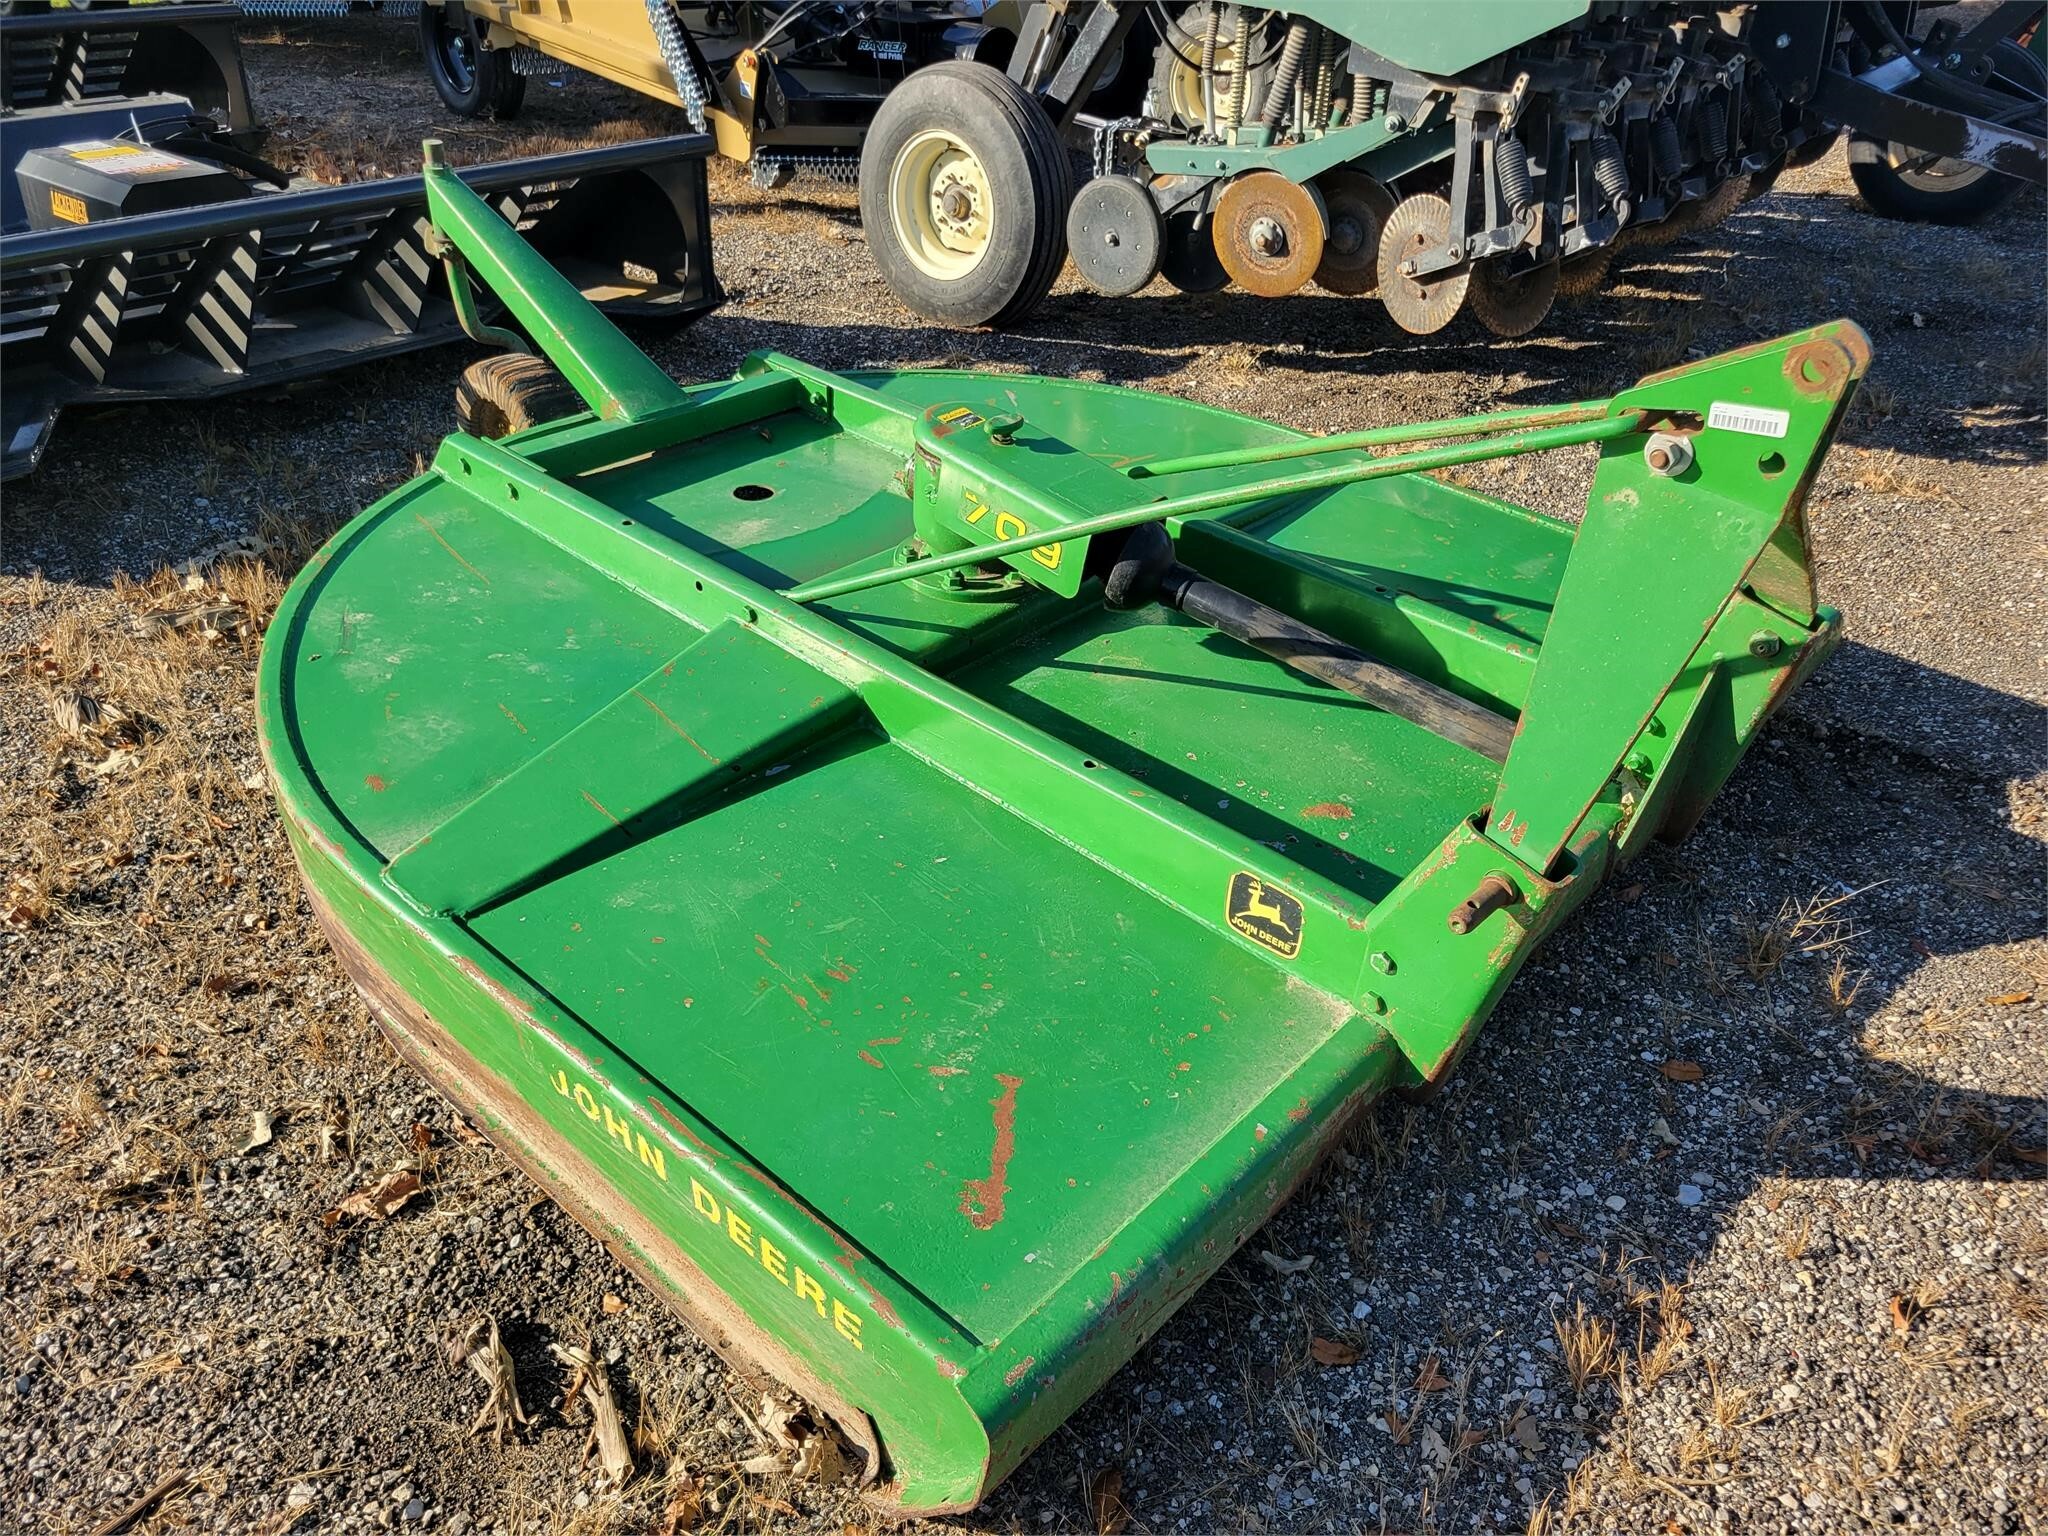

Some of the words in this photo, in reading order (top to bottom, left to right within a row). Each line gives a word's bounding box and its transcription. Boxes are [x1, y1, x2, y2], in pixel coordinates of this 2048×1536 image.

[858, 40, 907, 53] RANGER
[1231, 916, 1257, 935] JOHN
[1259, 929, 1291, 953] DEERE
[551, 1070, 667, 1181] JOHN
[691, 1176, 863, 1351] DEERE
